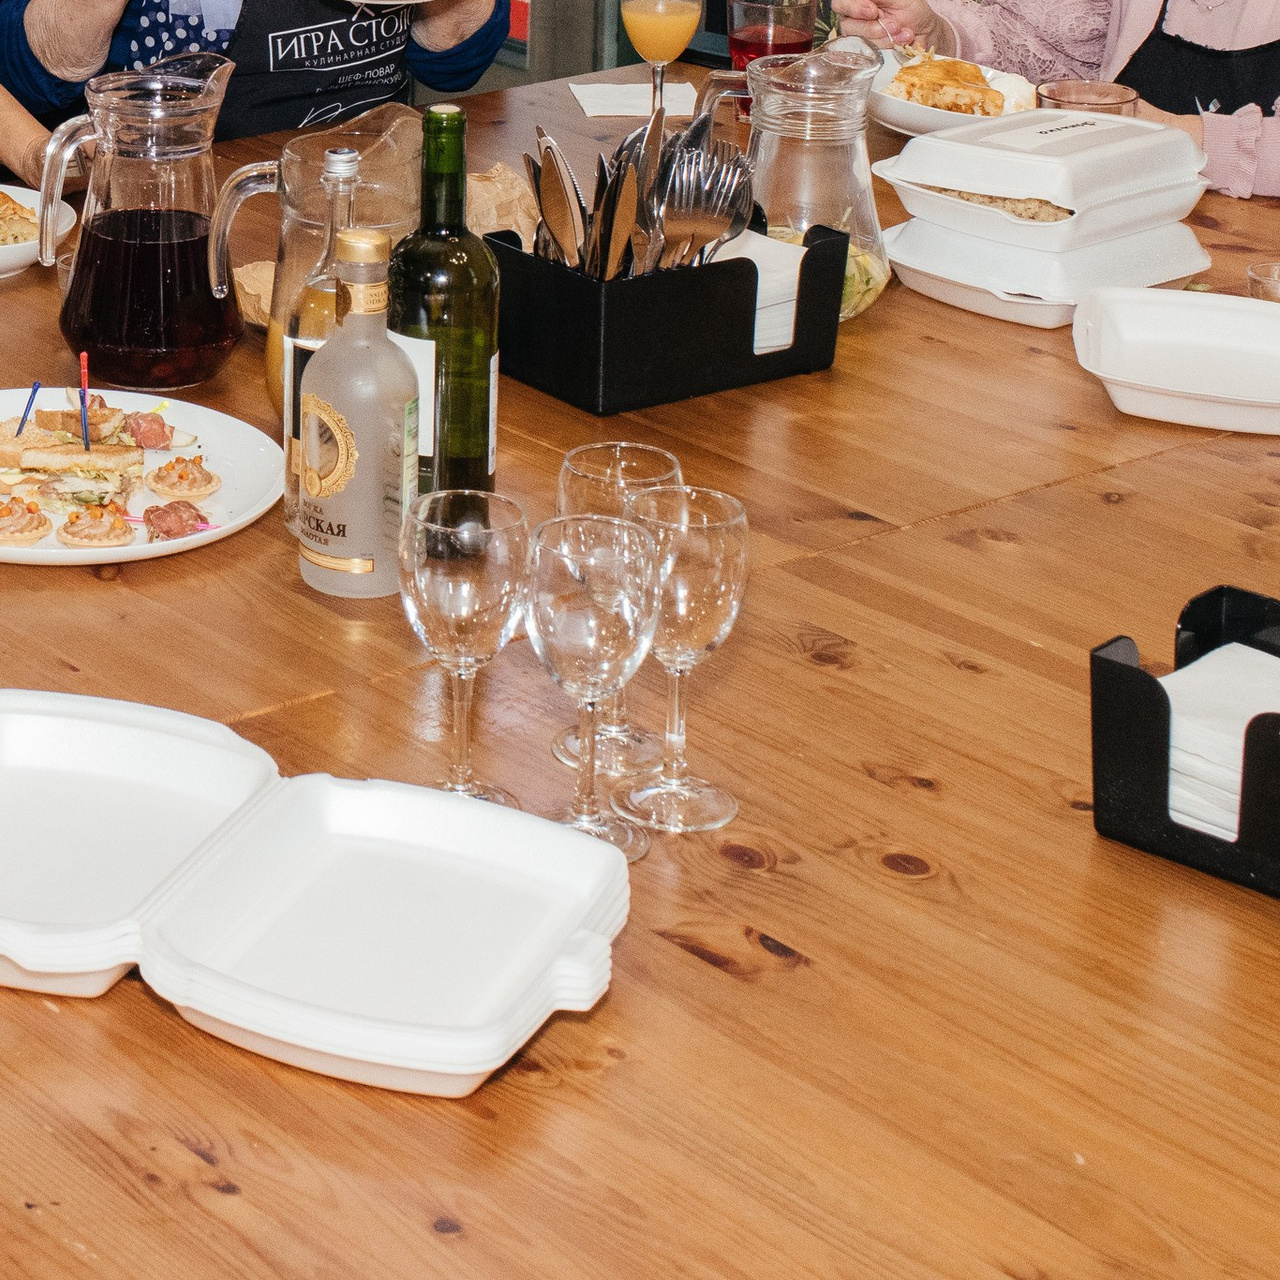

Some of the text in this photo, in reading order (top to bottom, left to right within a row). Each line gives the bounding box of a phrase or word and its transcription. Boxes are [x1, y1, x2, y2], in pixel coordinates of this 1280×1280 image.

[276, 28, 345, 61] ИГРА
[304, 31, 409, 67] КУЛИНАРНАЯ СТУДИ
[338, 63, 396, 84] ШЕФ-ПОВАР
